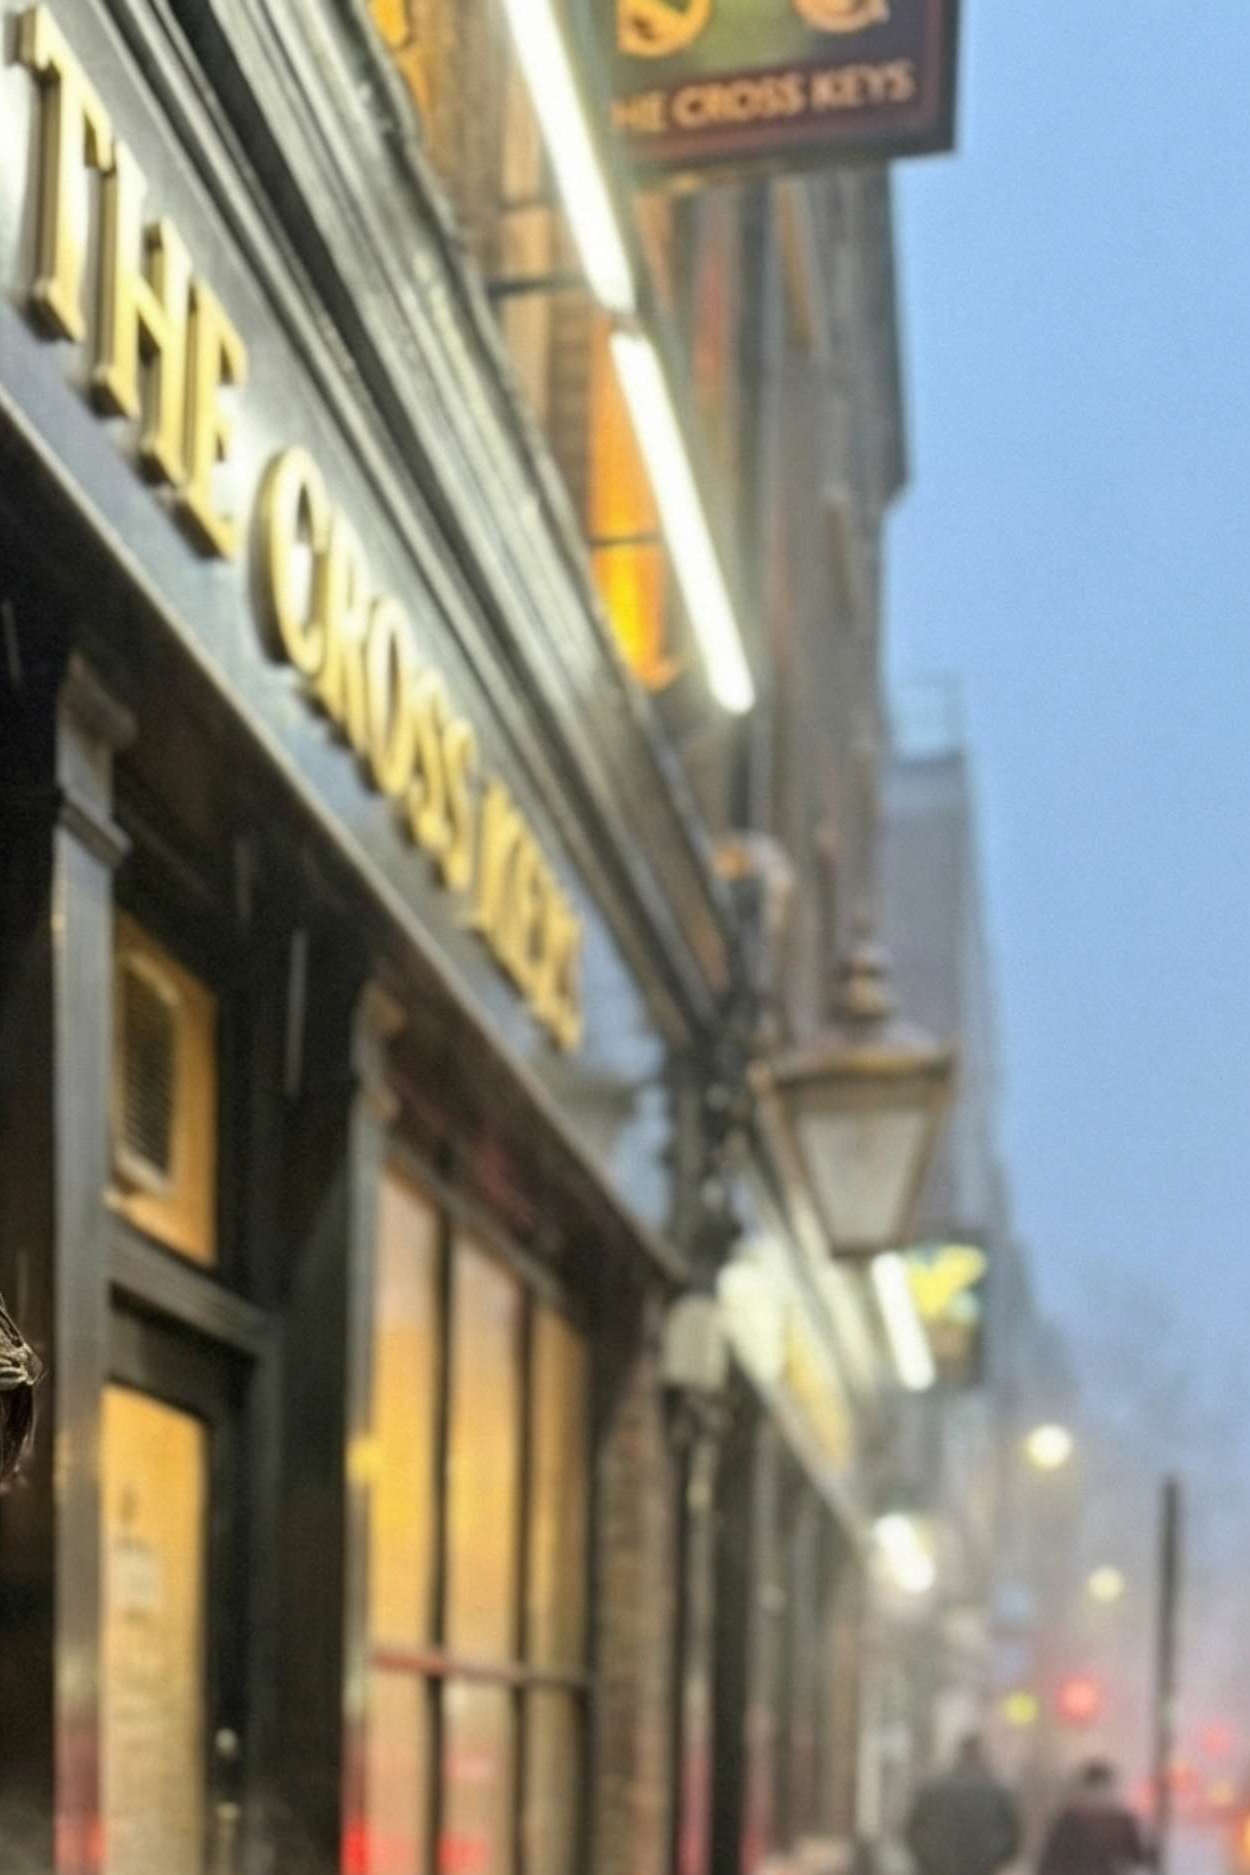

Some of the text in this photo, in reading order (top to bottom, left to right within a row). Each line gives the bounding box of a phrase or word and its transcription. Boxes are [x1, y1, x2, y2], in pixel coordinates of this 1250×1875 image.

[671, 73, 805, 128] CROSS
[810, 60, 916, 108] KEYS
[10, 4, 247, 561] THE
[260, 445, 477, 889] CROSS
